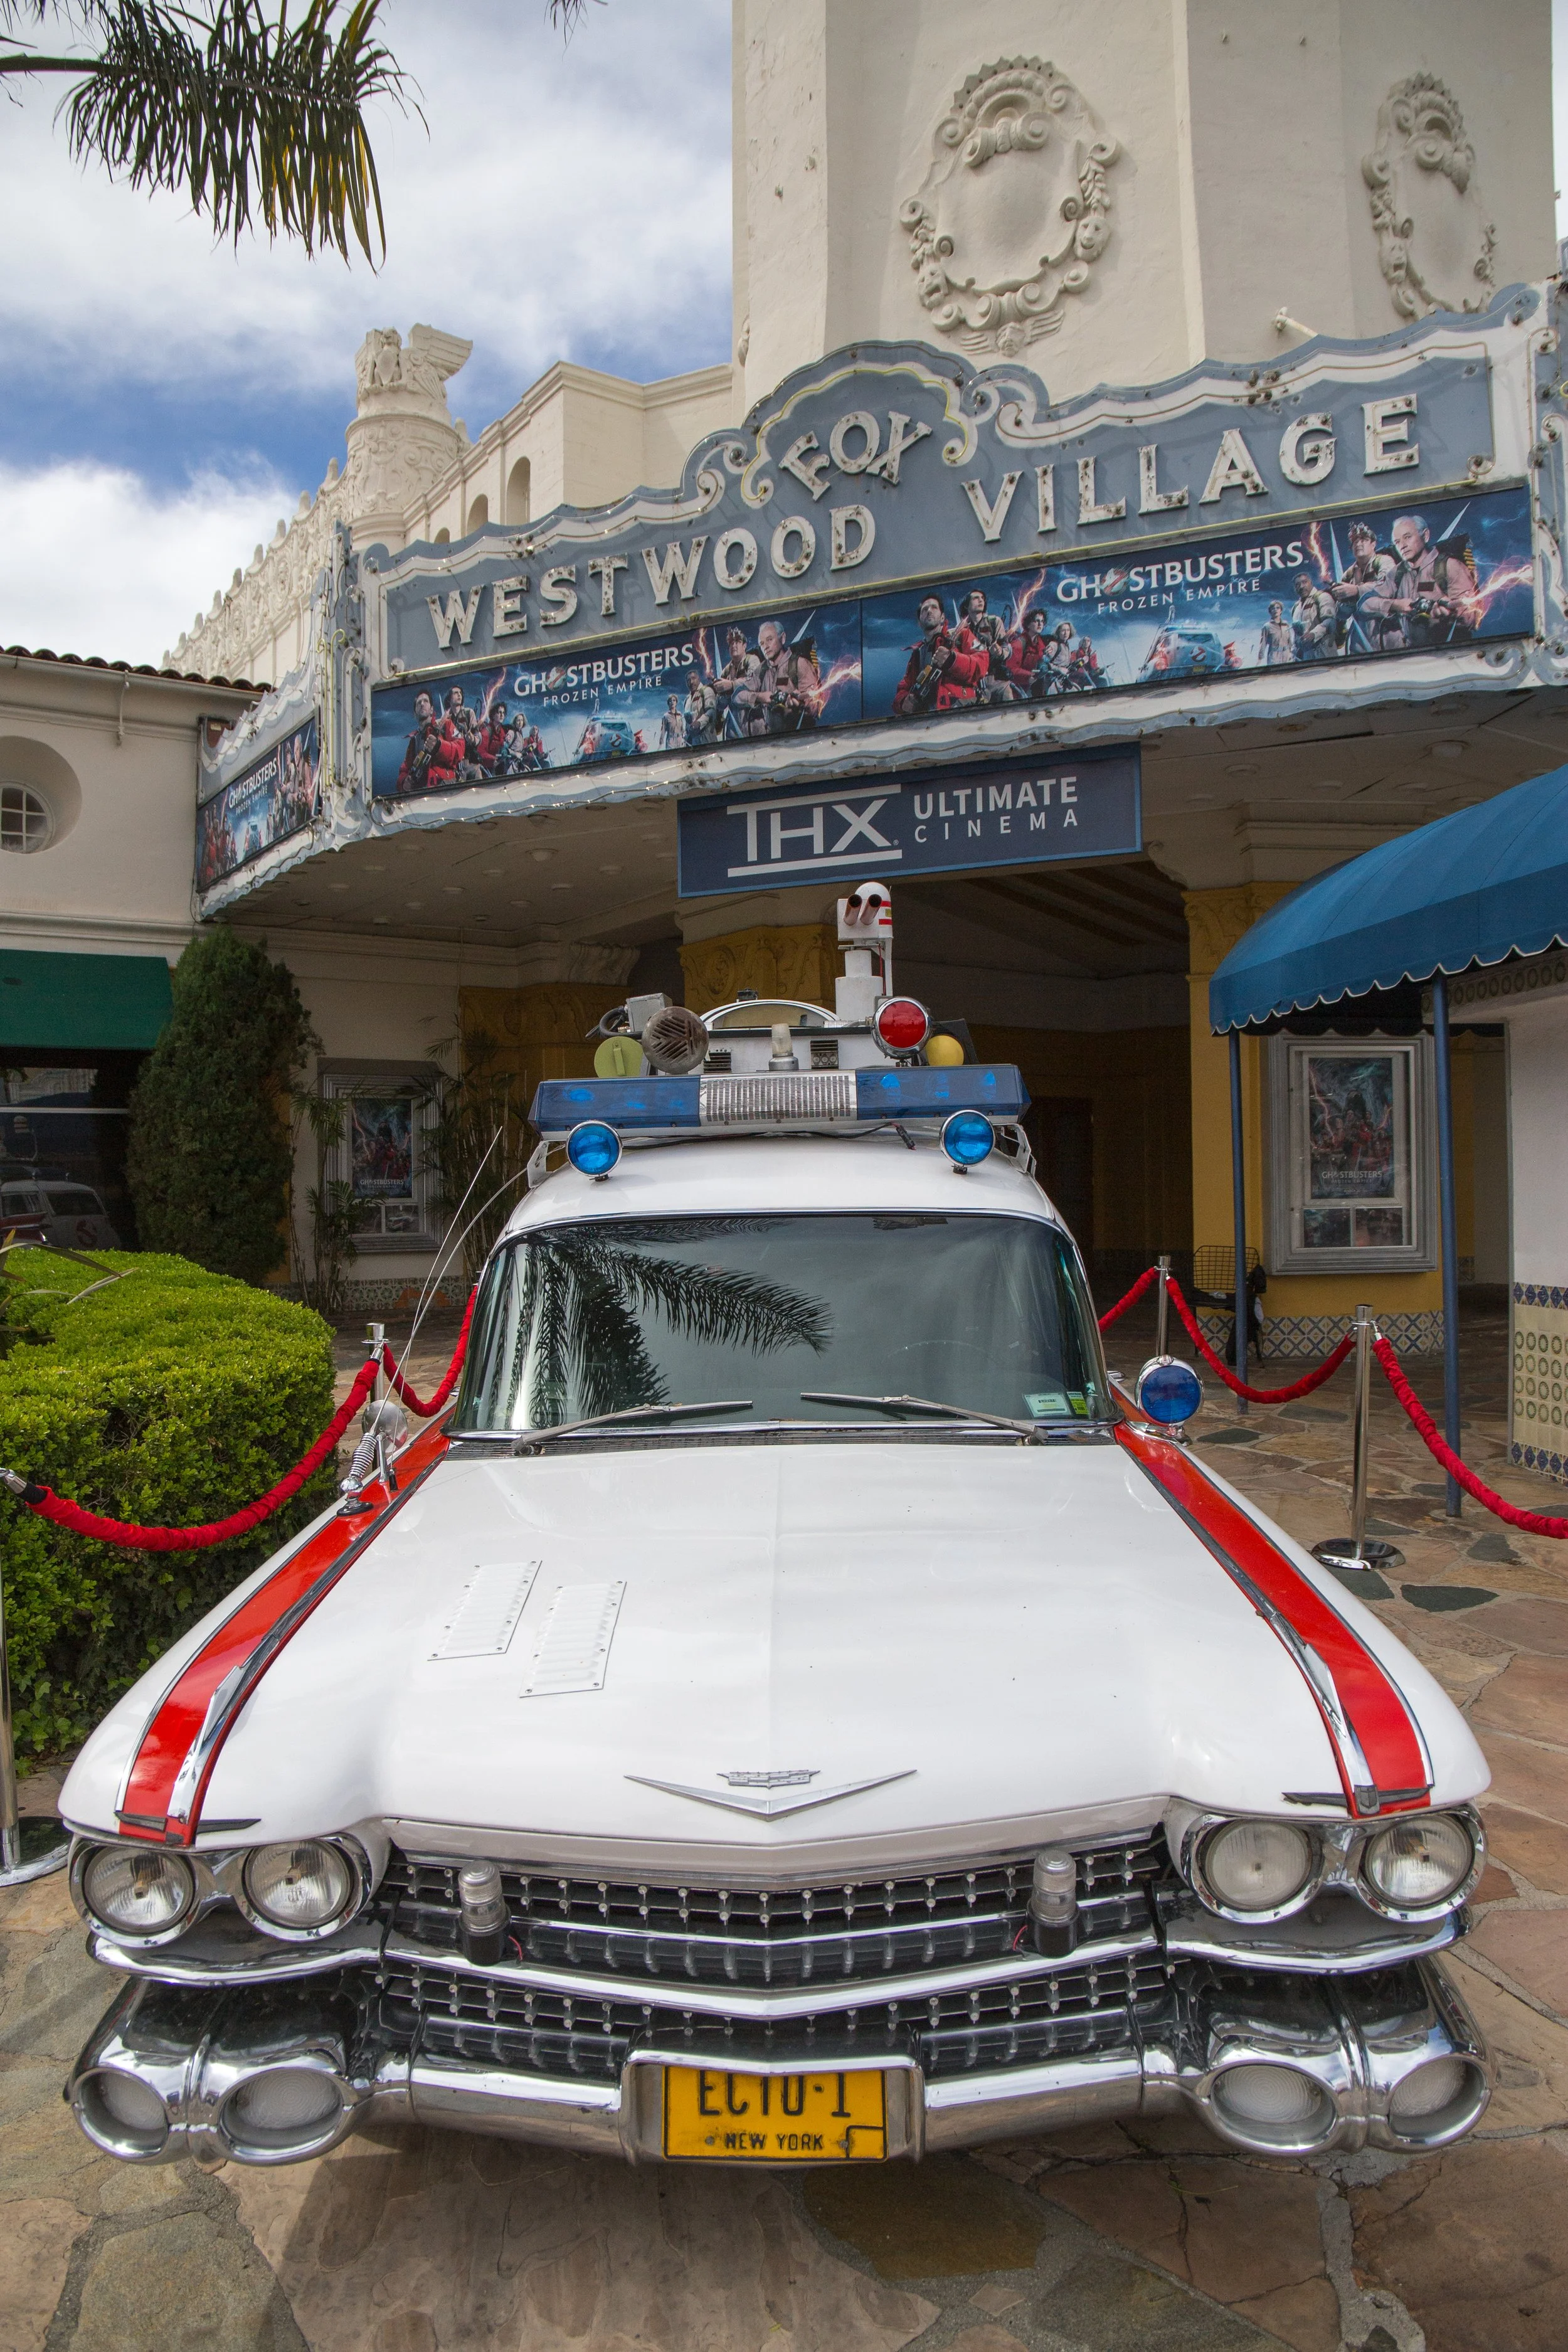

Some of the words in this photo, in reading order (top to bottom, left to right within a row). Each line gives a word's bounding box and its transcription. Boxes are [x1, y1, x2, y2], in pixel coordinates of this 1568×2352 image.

[779, 411, 933, 501] FOX
[425, 504, 876, 650] WESTWOOD
[961, 393, 1419, 542] VILLAGE
[1057, 541, 1304, 603] GHOSTBUSTERS
[1098, 592, 1173, 615] FROZEN
[1186, 579, 1261, 601] EMPIRE
[514, 644, 694, 697] GHOSTBUSTERS
[543, 687, 599, 707] FROZEN
[608, 675, 662, 696] EMPIRE
[229, 757, 277, 808] GHOSTBUSTERS
[913, 776, 1079, 820] ULTIMATE
[727, 784, 902, 864] THX
[913, 808, 1079, 843] CINEMA
[724, 2132, 765, 2149] NEW
[776, 2133, 824, 2151] YORK
